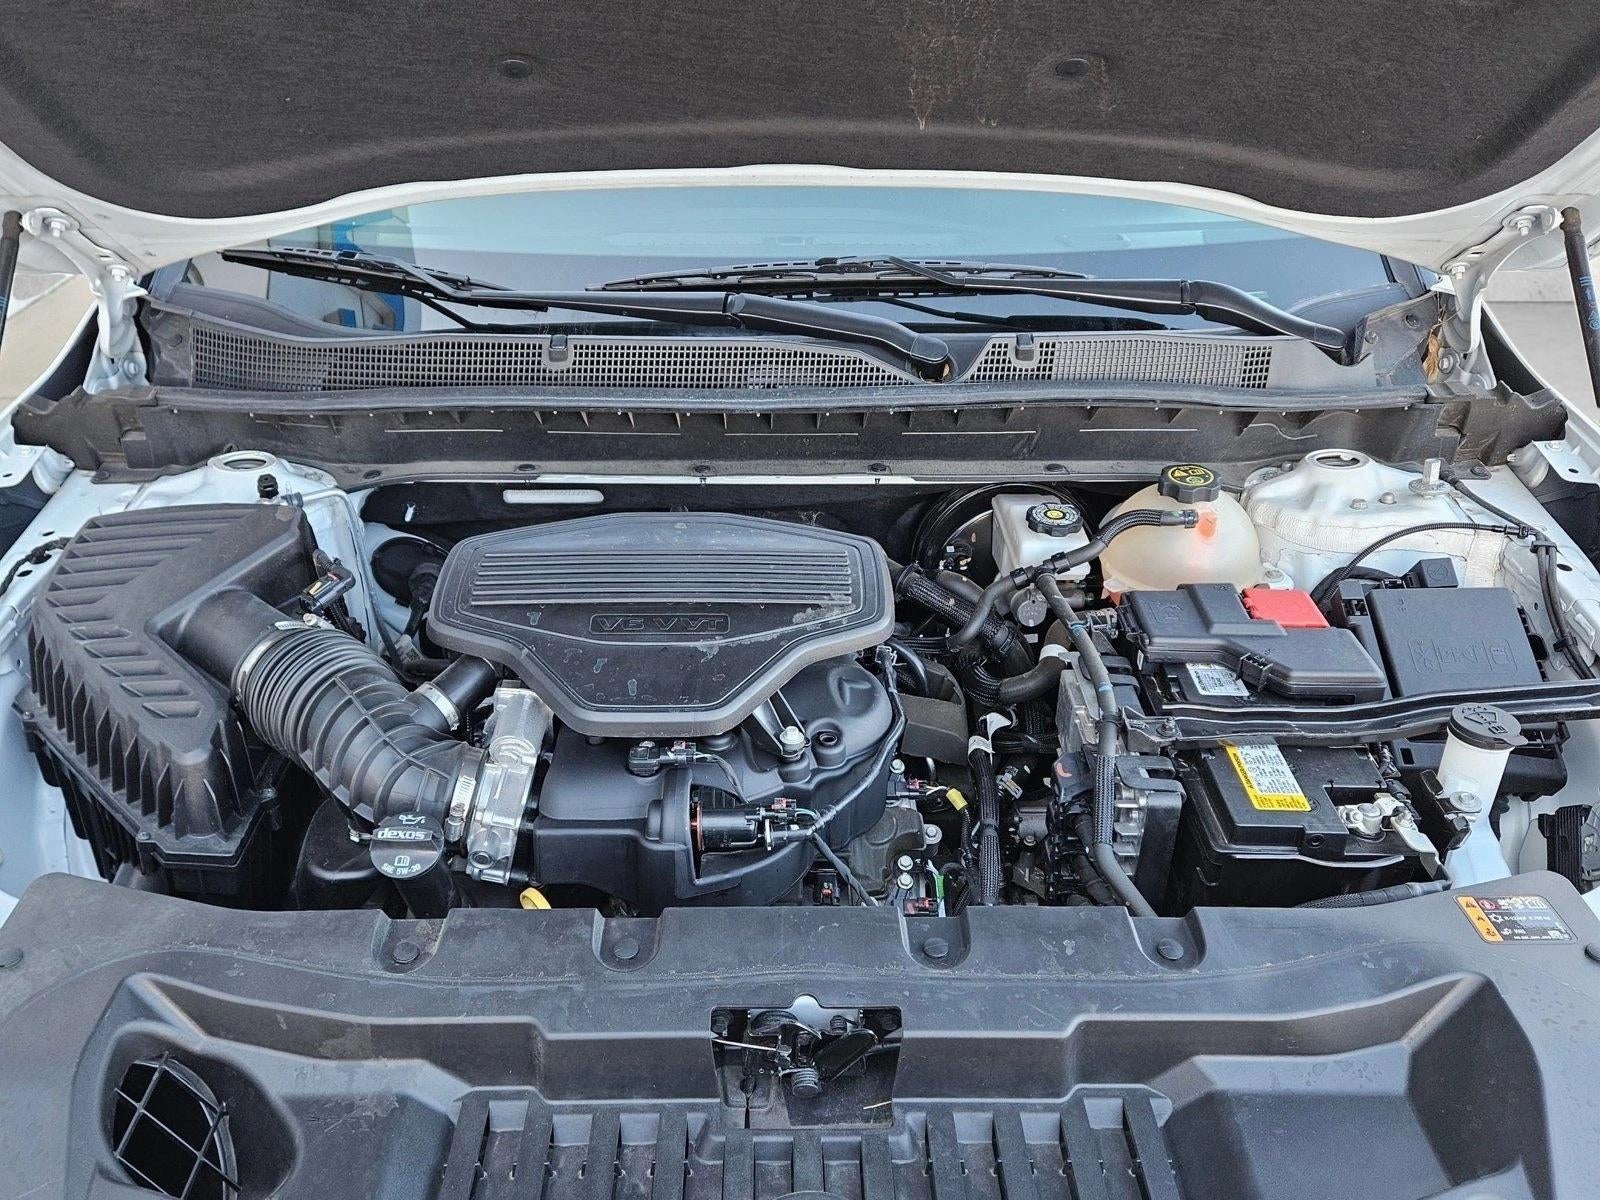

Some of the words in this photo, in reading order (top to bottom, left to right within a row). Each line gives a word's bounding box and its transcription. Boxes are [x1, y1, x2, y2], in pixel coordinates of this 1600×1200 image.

[598, 617, 645, 631] V6
[652, 617, 724, 631] VVT
[377, 828, 426, 840] dexos
[381, 862, 395, 874] SAE
[396, 863, 421, 875] 5W-30
